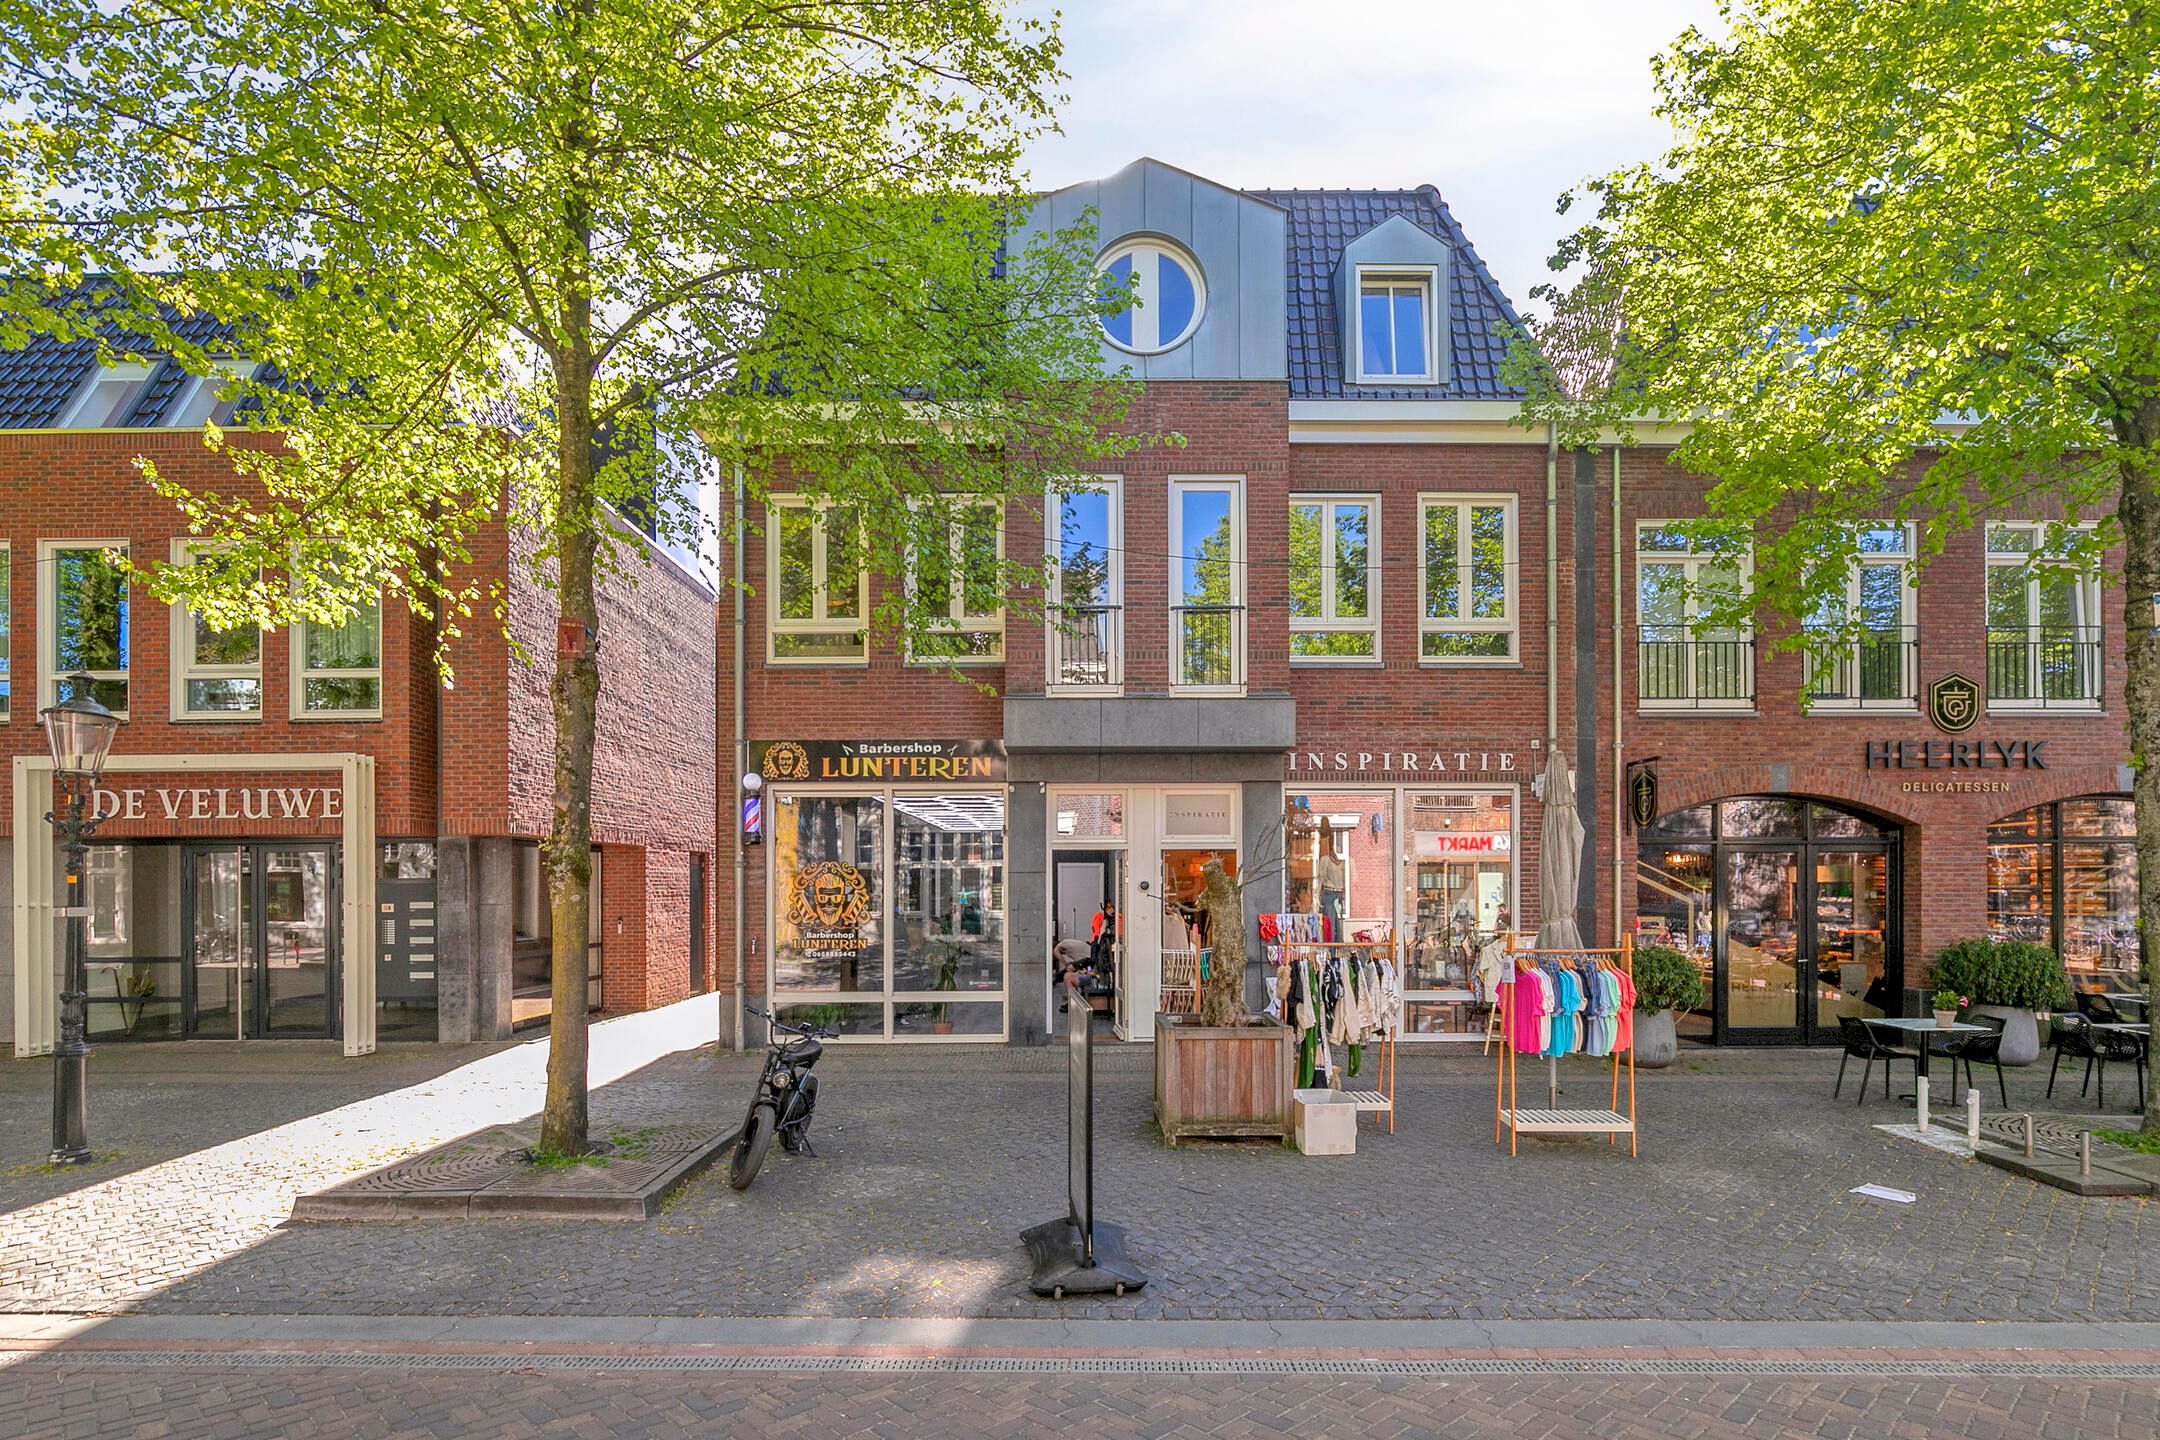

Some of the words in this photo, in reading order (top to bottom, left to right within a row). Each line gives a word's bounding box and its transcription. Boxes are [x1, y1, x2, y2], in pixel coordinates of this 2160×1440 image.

[859, 743, 942, 755] Barbershop
[1866, 741, 2051, 769] HEERLYK
[821, 756, 993, 780] LUNTEREN
[1287, 752, 1515, 771] INSPIRATIE
[1902, 782, 2010, 793] DELICATESSEN
[89, 789, 147, 820] DE
[155, 788, 343, 820] VELUWE
[806, 931, 855, 940] Barbershop
[792, 938, 868, 950] LUNTEREN
